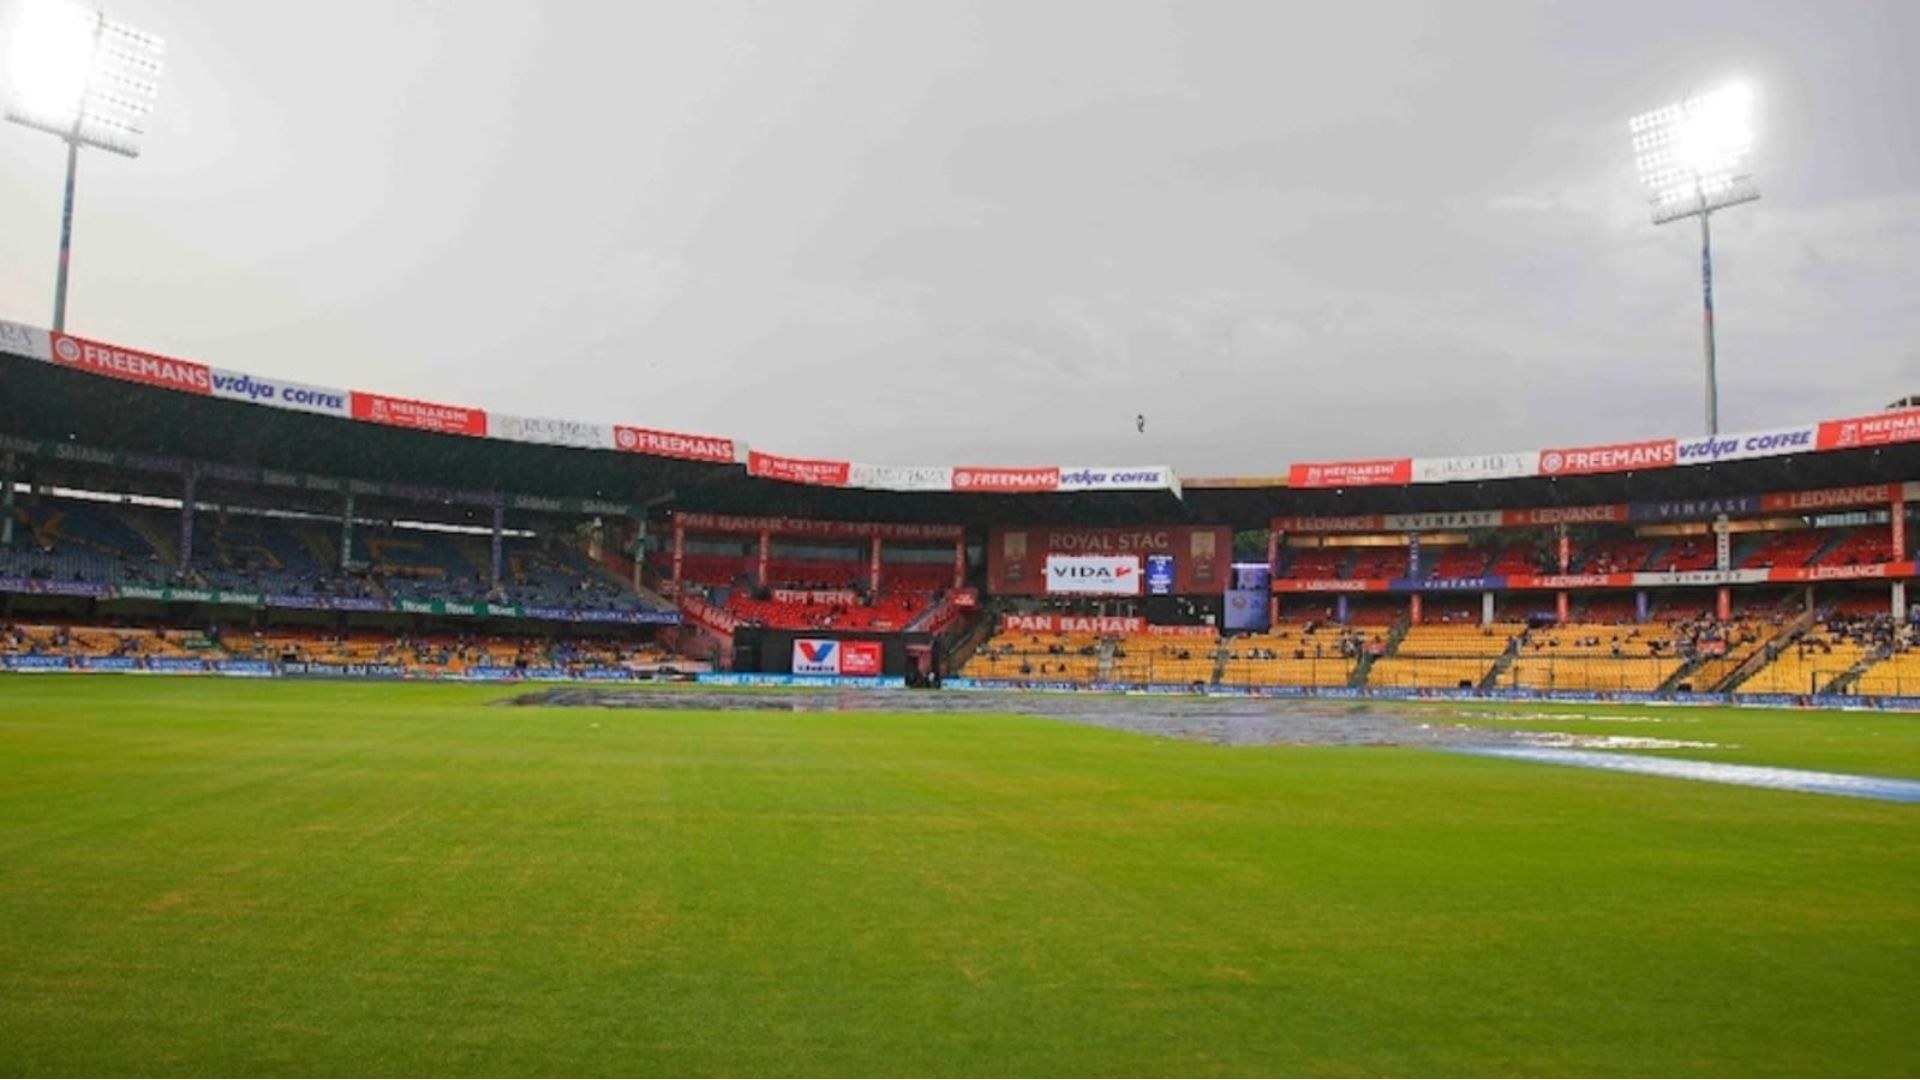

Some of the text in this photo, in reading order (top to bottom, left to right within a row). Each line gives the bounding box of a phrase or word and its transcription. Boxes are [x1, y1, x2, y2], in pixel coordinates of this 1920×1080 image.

[84, 346, 208, 390] FREEMANS
[283, 387, 344, 409] COFFEE
[638, 431, 732, 459] FREEMANS
[1745, 428, 1812, 451] COFFEE
[1565, 443, 1674, 468] FREEMANS
[972, 471, 1057, 487] FREEMANS
[1112, 472, 1160, 484] COFFEE
[1790, 487, 1888, 507] LEDVANCE
[1530, 505, 1615, 524] LEDVANCE
[1660, 499, 1749, 516] VINFAST
[1296, 517, 1374, 530] LEDVANCE
[1050, 532, 1168, 549] ROYAL STAG
[1053, 567, 1111, 577] VIDA
[1809, 563, 1885, 579] LEDVANCE
[1008, 616, 1050, 632] PAN
[1060, 616, 1140, 634] BAHAR
